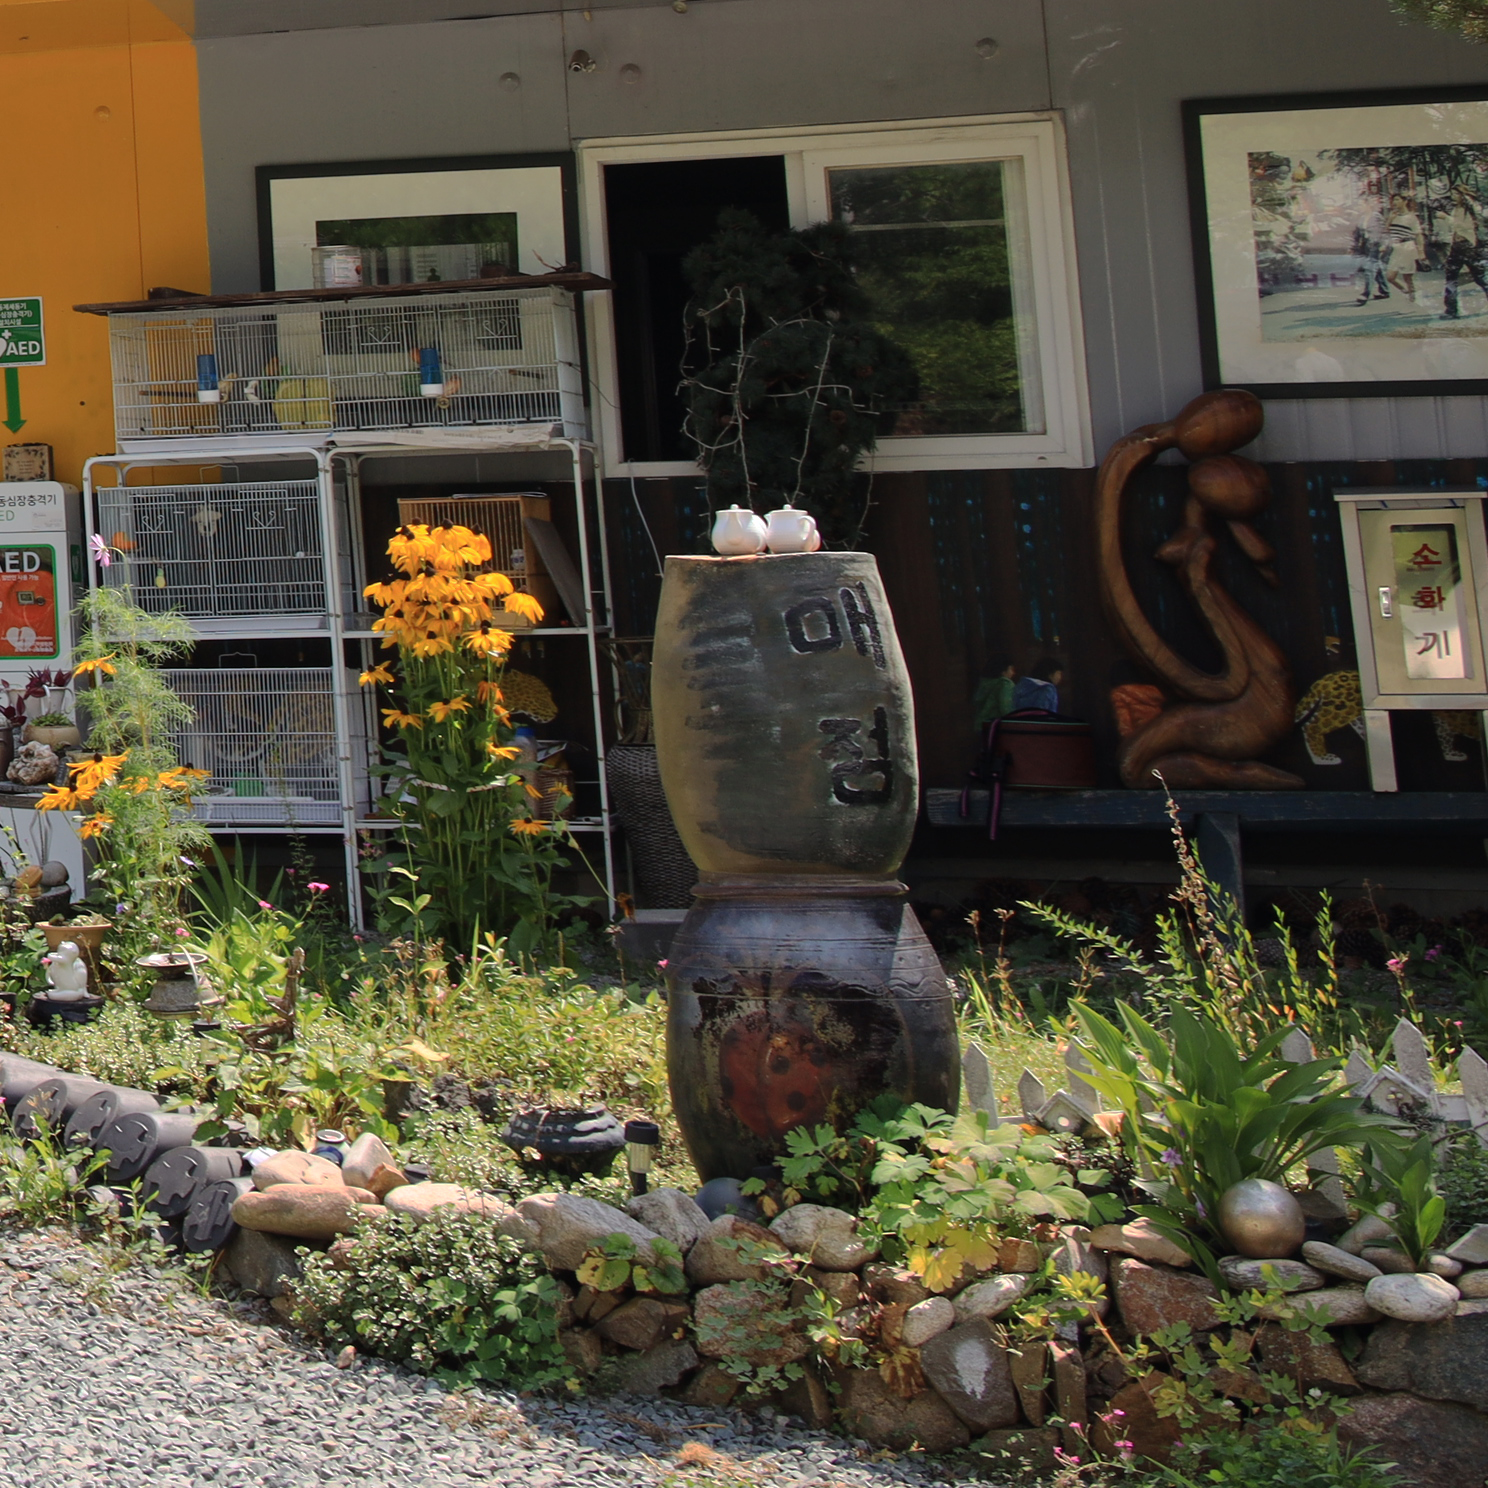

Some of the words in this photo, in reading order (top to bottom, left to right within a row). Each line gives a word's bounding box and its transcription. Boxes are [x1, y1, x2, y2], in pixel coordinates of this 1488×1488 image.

[6, 341, 41, 356] AED
[1411, 543, 1452, 660] 소화기
[783, 581, 894, 805] 매점
